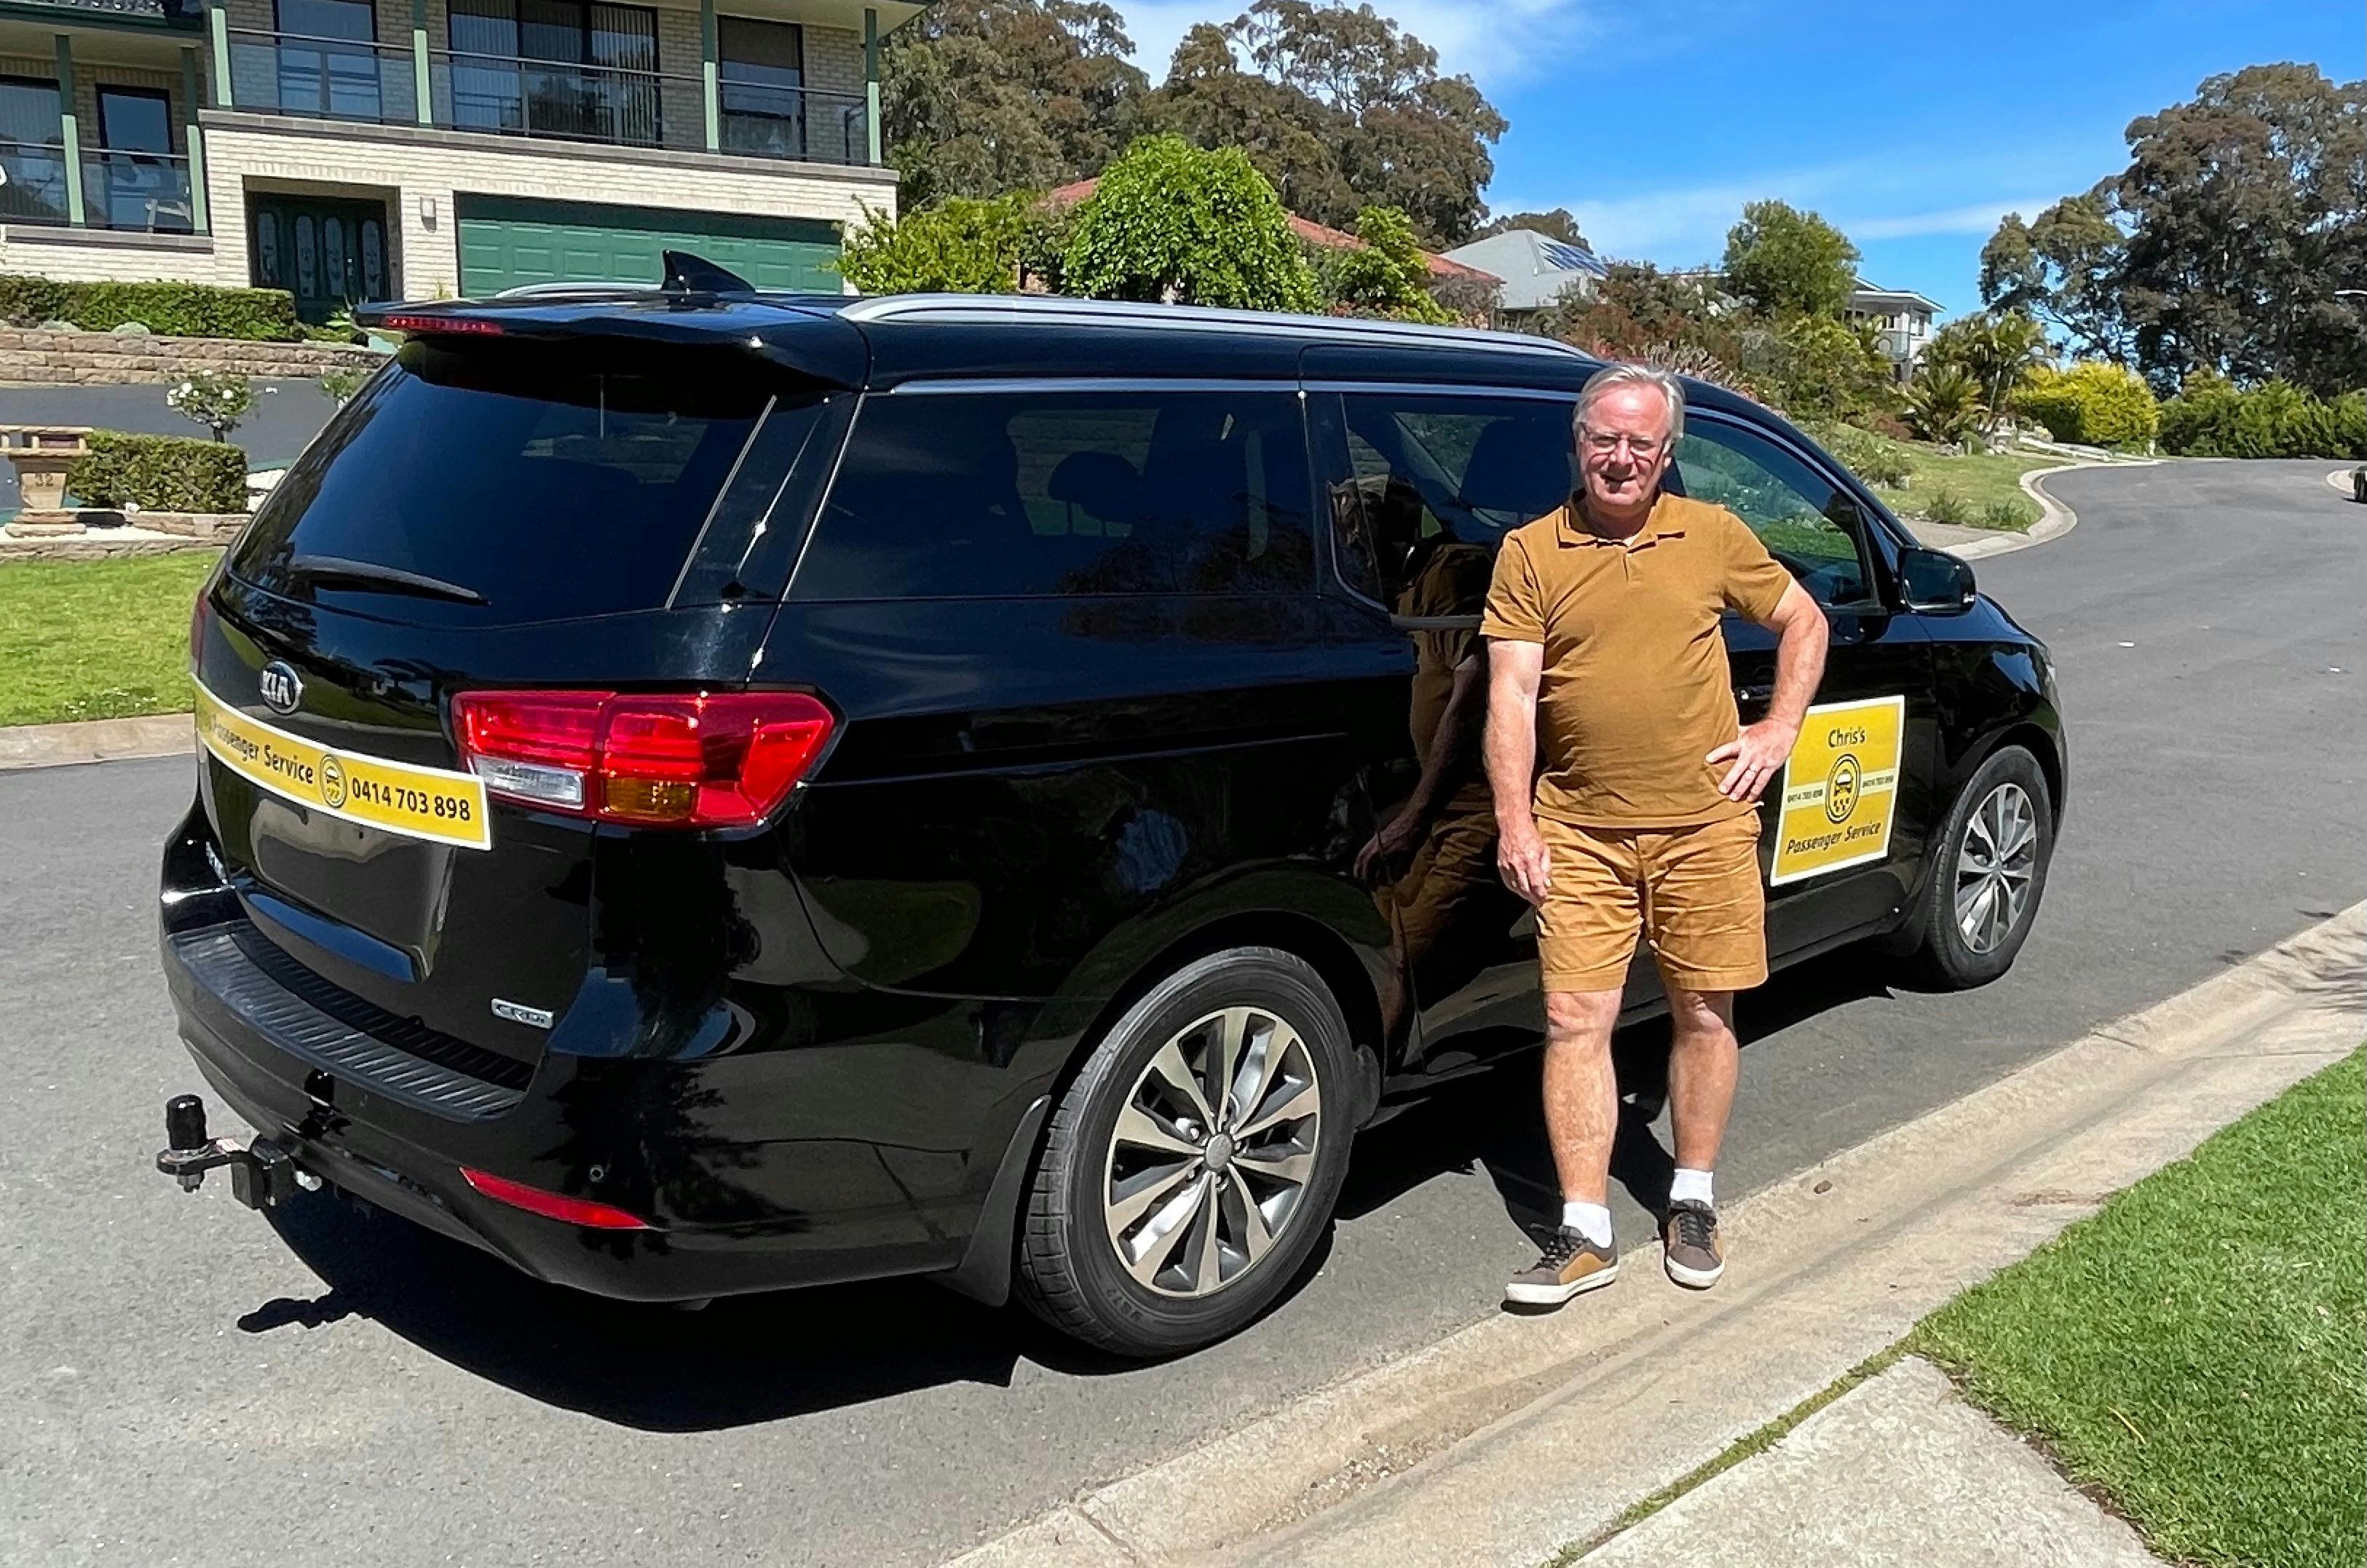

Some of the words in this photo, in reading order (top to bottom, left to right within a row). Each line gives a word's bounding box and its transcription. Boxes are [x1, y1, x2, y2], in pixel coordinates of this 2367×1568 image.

[260, 670, 292, 706] KIA
[1827, 725, 1865, 748] Chris's
[264, 744, 313, 784] Service
[352, 777, 392, 807] 0414
[395, 787, 430, 814] 703
[435, 795, 471, 822] 898
[1785, 831, 1843, 855] Passenger
[1844, 820, 1881, 842] Service
